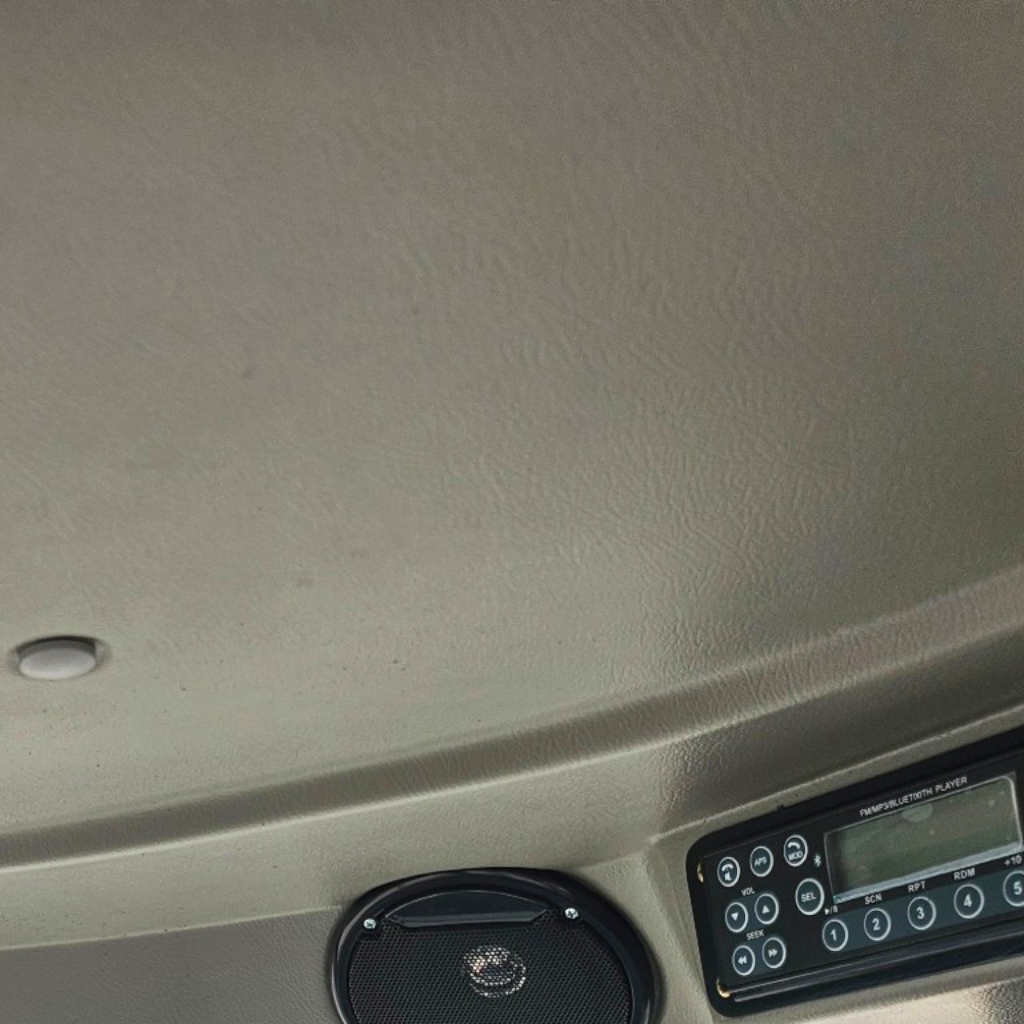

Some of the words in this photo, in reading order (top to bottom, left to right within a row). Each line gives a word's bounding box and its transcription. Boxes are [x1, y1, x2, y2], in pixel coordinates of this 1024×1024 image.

[935, 776, 968, 793] PLAYER
[1003, 854, 1023, 867] +10
[953, 868, 976, 881] RDM
[741, 886, 755, 897] VOL
[907, 881, 926, 893] RPT
[1013, 881, 1023, 896] 5
[800, 892, 817, 902] SEL
[864, 893, 882, 905] SCN
[963, 894, 973, 907] 4
[916, 906, 925, 920] 3
[871, 918, 880, 931] 2
[746, 929, 765, 941] SEEK
[830, 929, 837, 942] 1
